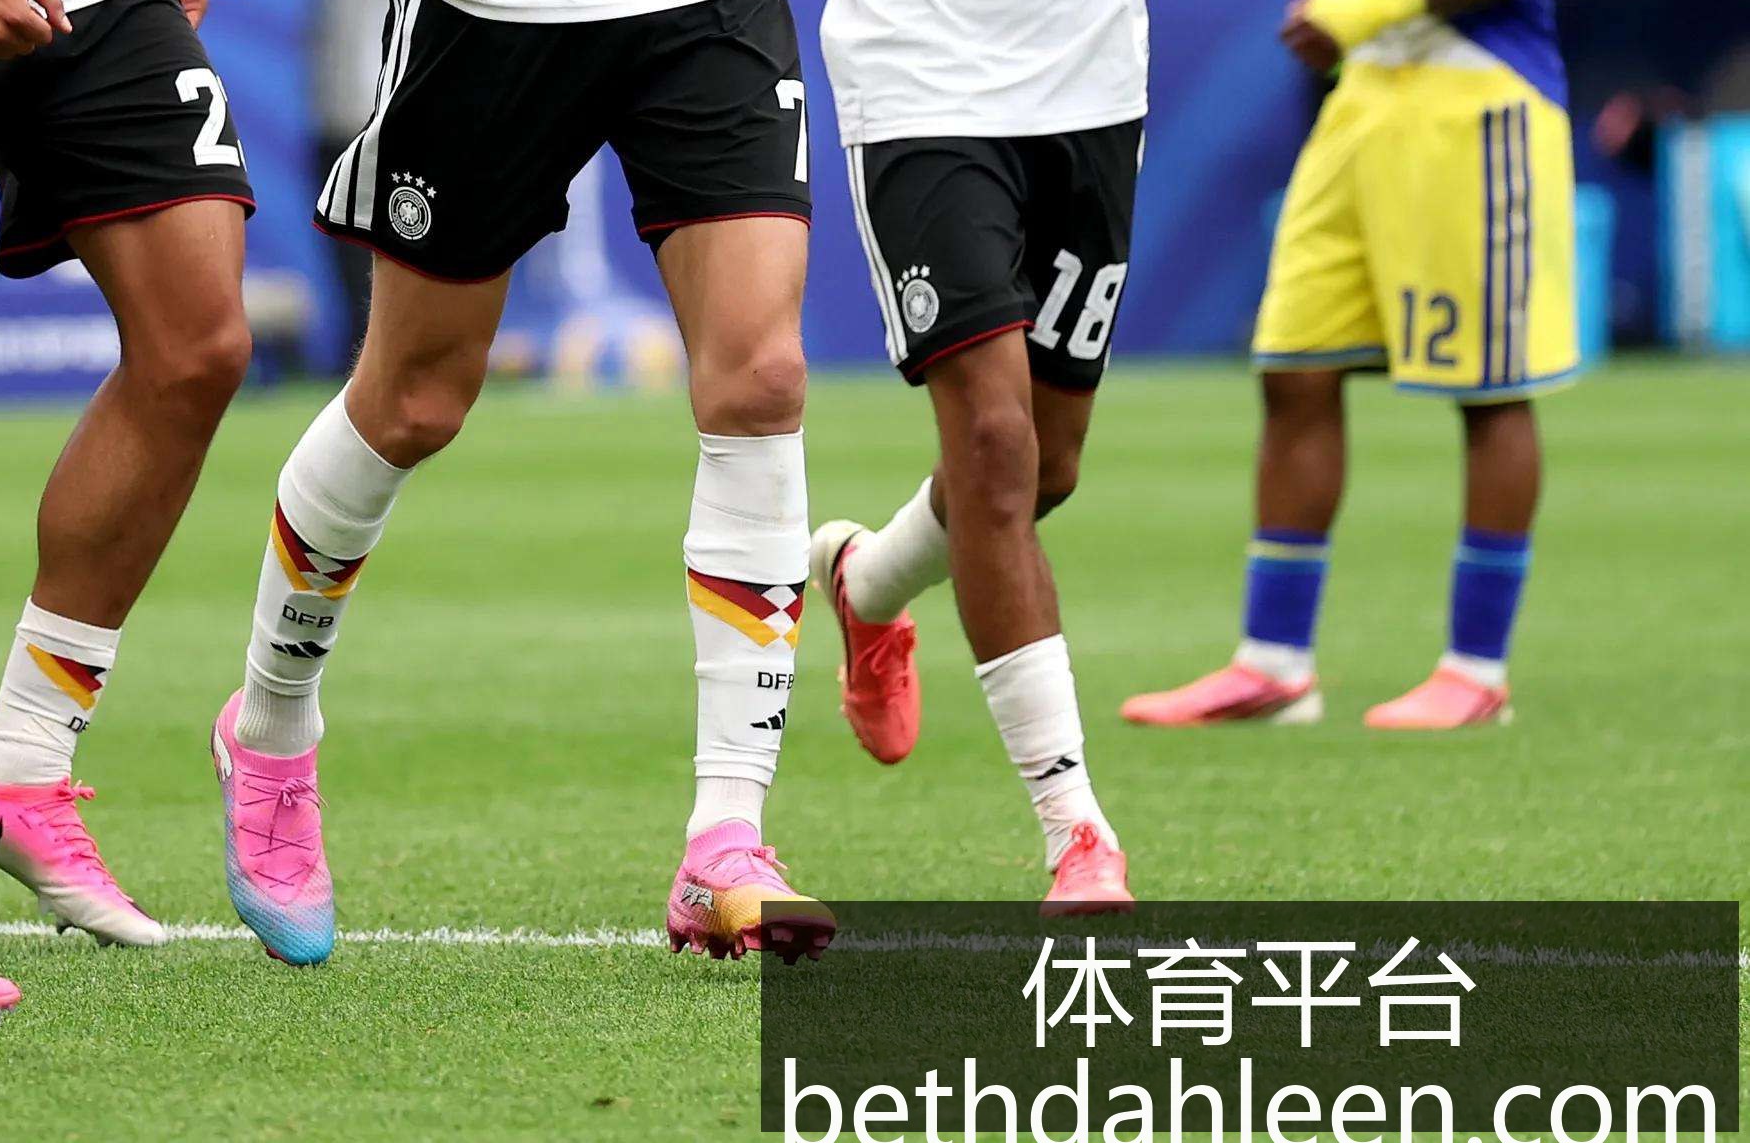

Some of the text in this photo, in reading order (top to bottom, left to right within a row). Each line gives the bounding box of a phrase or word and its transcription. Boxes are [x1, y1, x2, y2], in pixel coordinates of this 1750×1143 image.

[175, 67, 247, 172] 2
[1028, 248, 1129, 360] 18
[1401, 288, 1458, 365] 12
[282, 604, 335, 628] DFB
